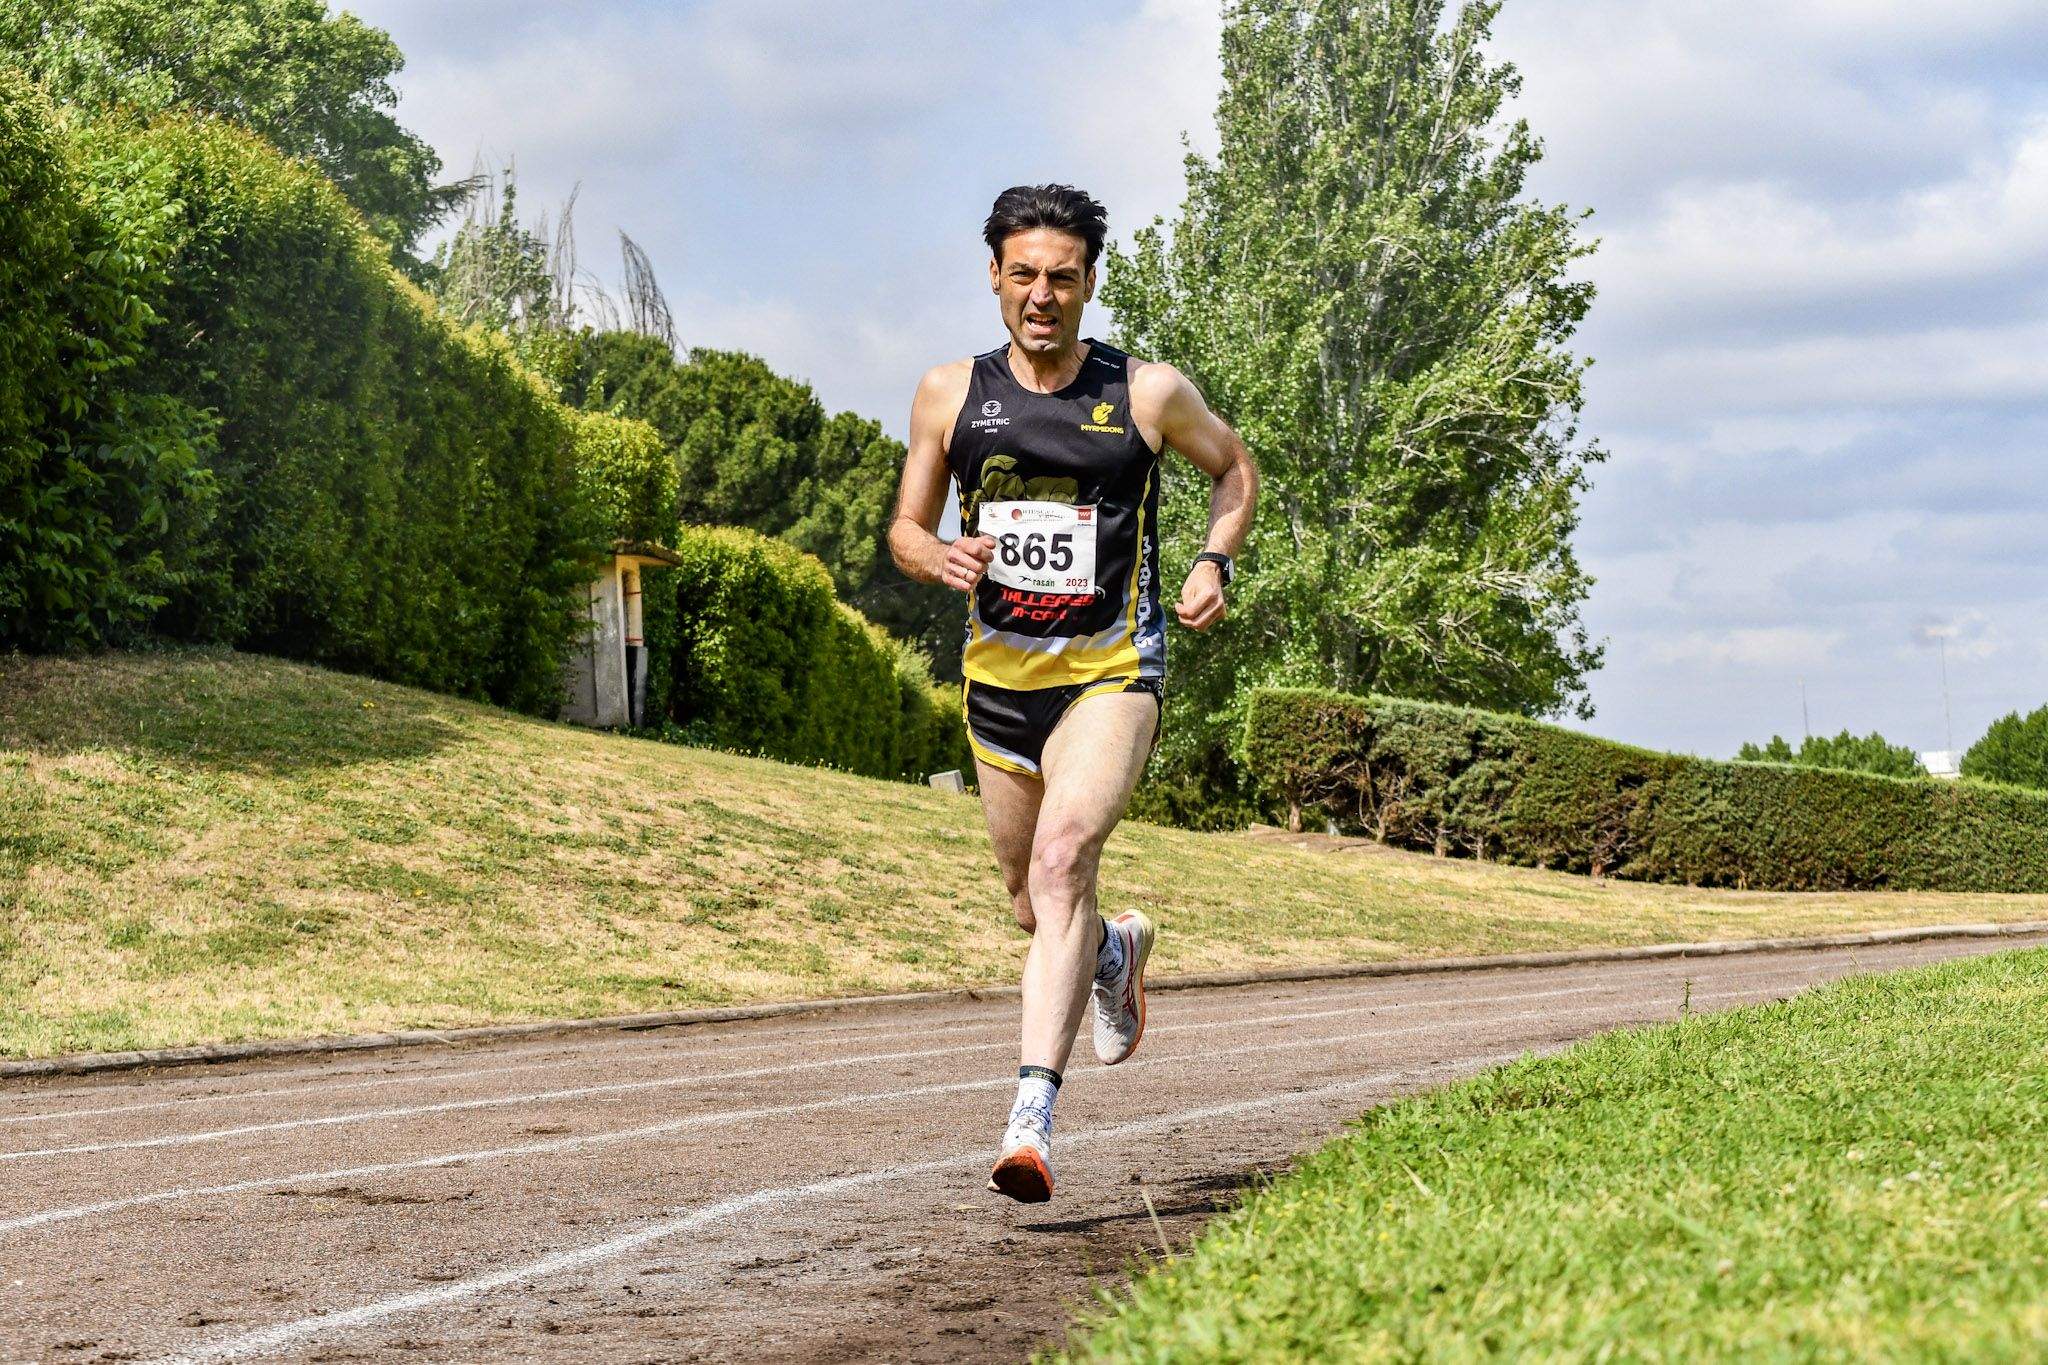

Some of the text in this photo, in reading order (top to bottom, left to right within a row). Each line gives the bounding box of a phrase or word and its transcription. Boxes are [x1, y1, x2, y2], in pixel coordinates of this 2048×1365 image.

[970, 418, 1010, 429] ZYMETRIC
[1080, 424, 1124, 435] MYRMIDONS
[999, 532, 1073, 571] 865
[1065, 578, 1088, 587] 2023
